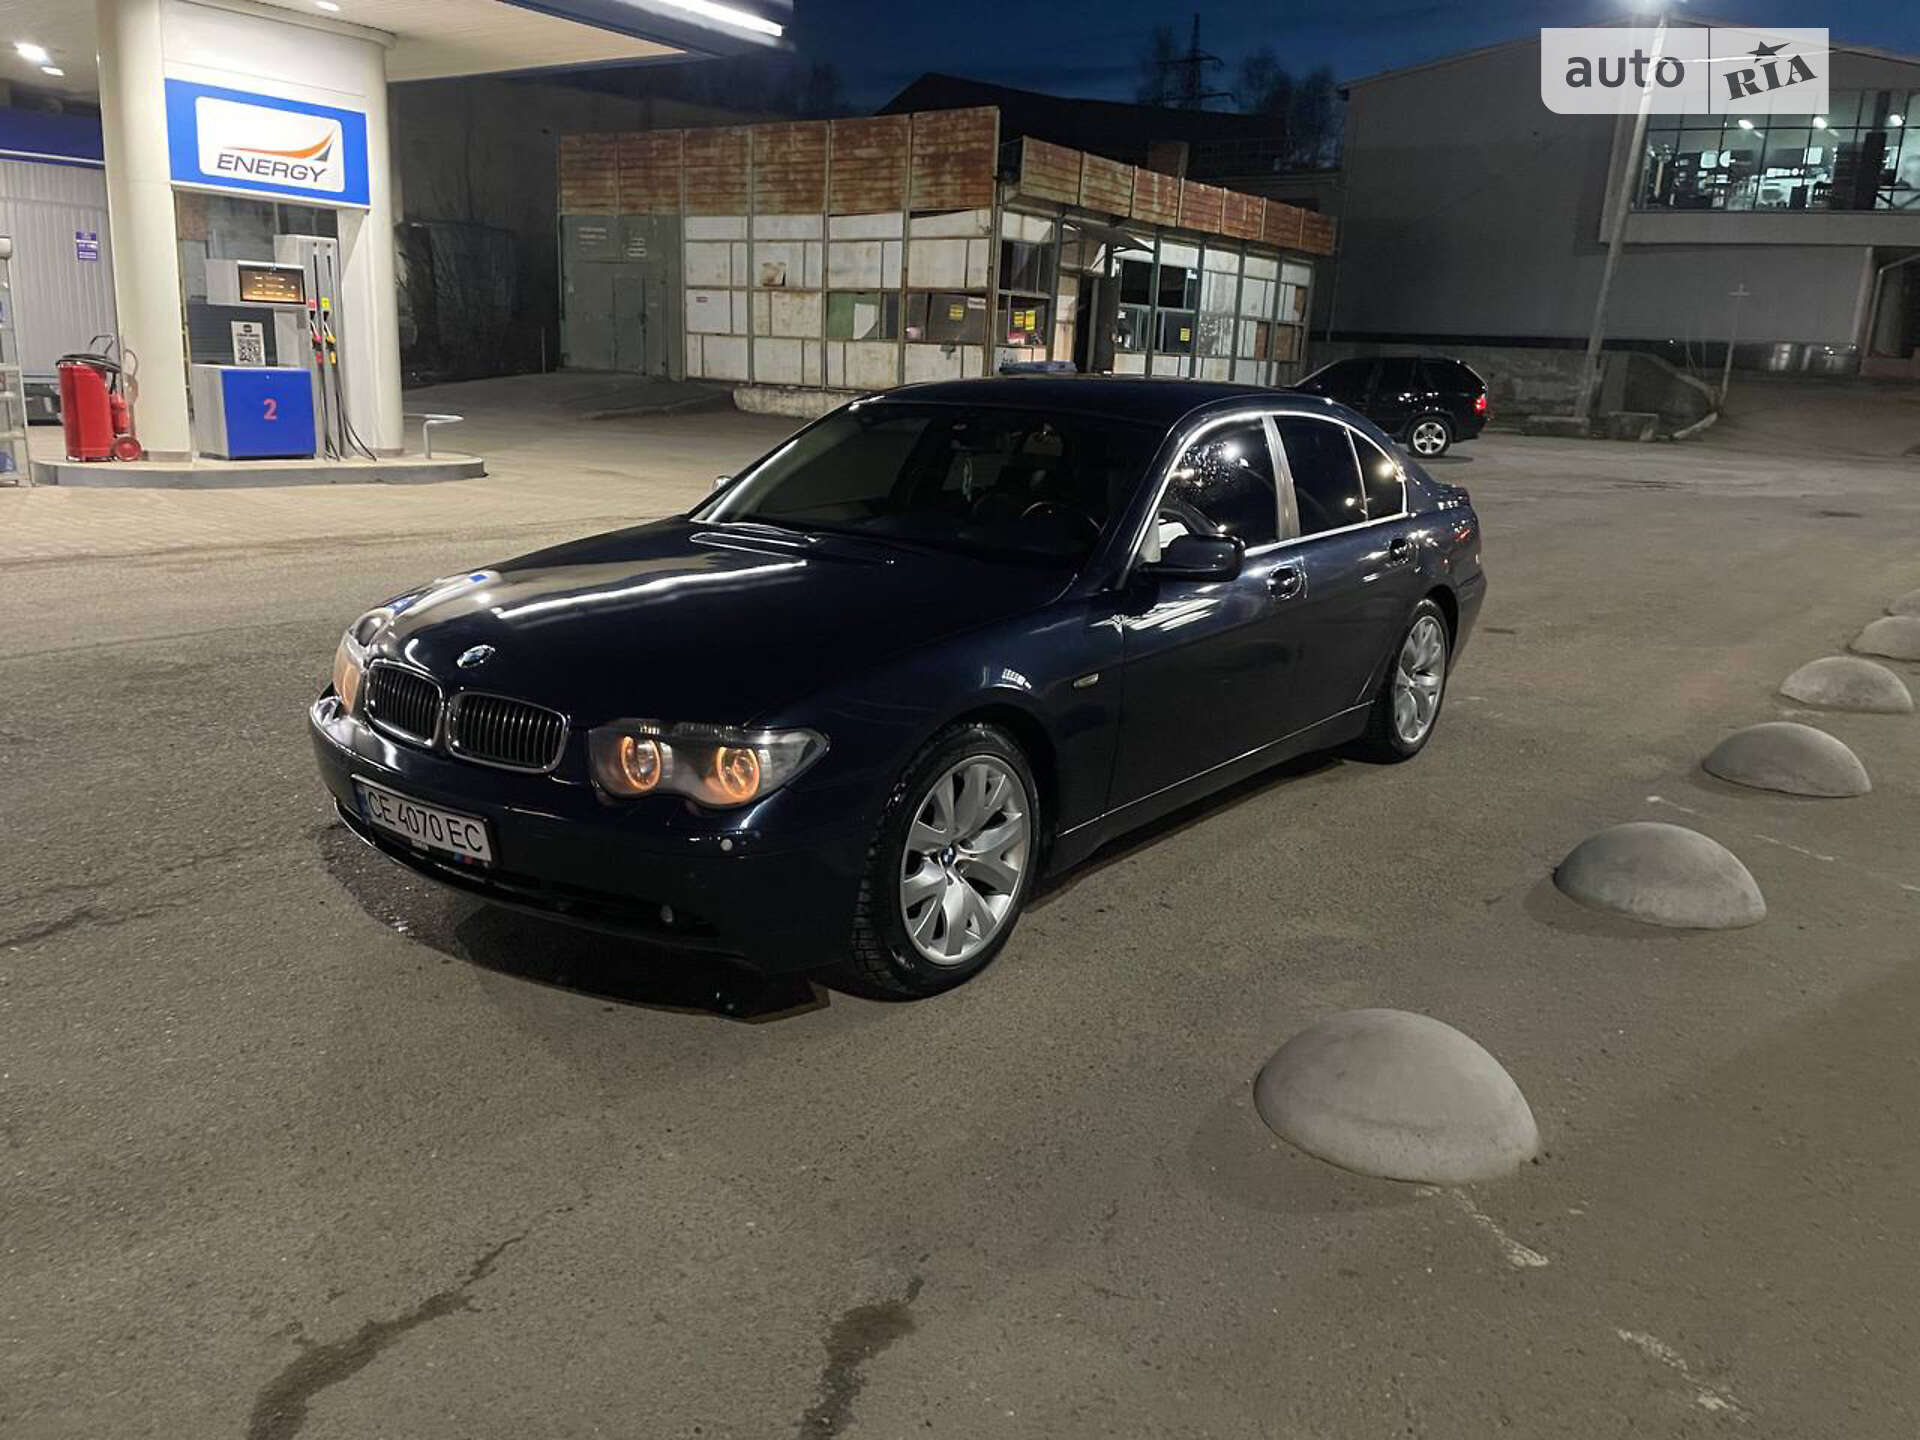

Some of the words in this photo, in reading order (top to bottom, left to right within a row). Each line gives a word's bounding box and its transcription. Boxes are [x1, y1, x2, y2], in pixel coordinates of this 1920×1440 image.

[217, 153, 327, 183] ENERGY
[263, 398, 278, 420] 2
[368, 791, 396, 826] CE
[398, 804, 444, 842] 4070
[447, 818, 483, 852] EC
